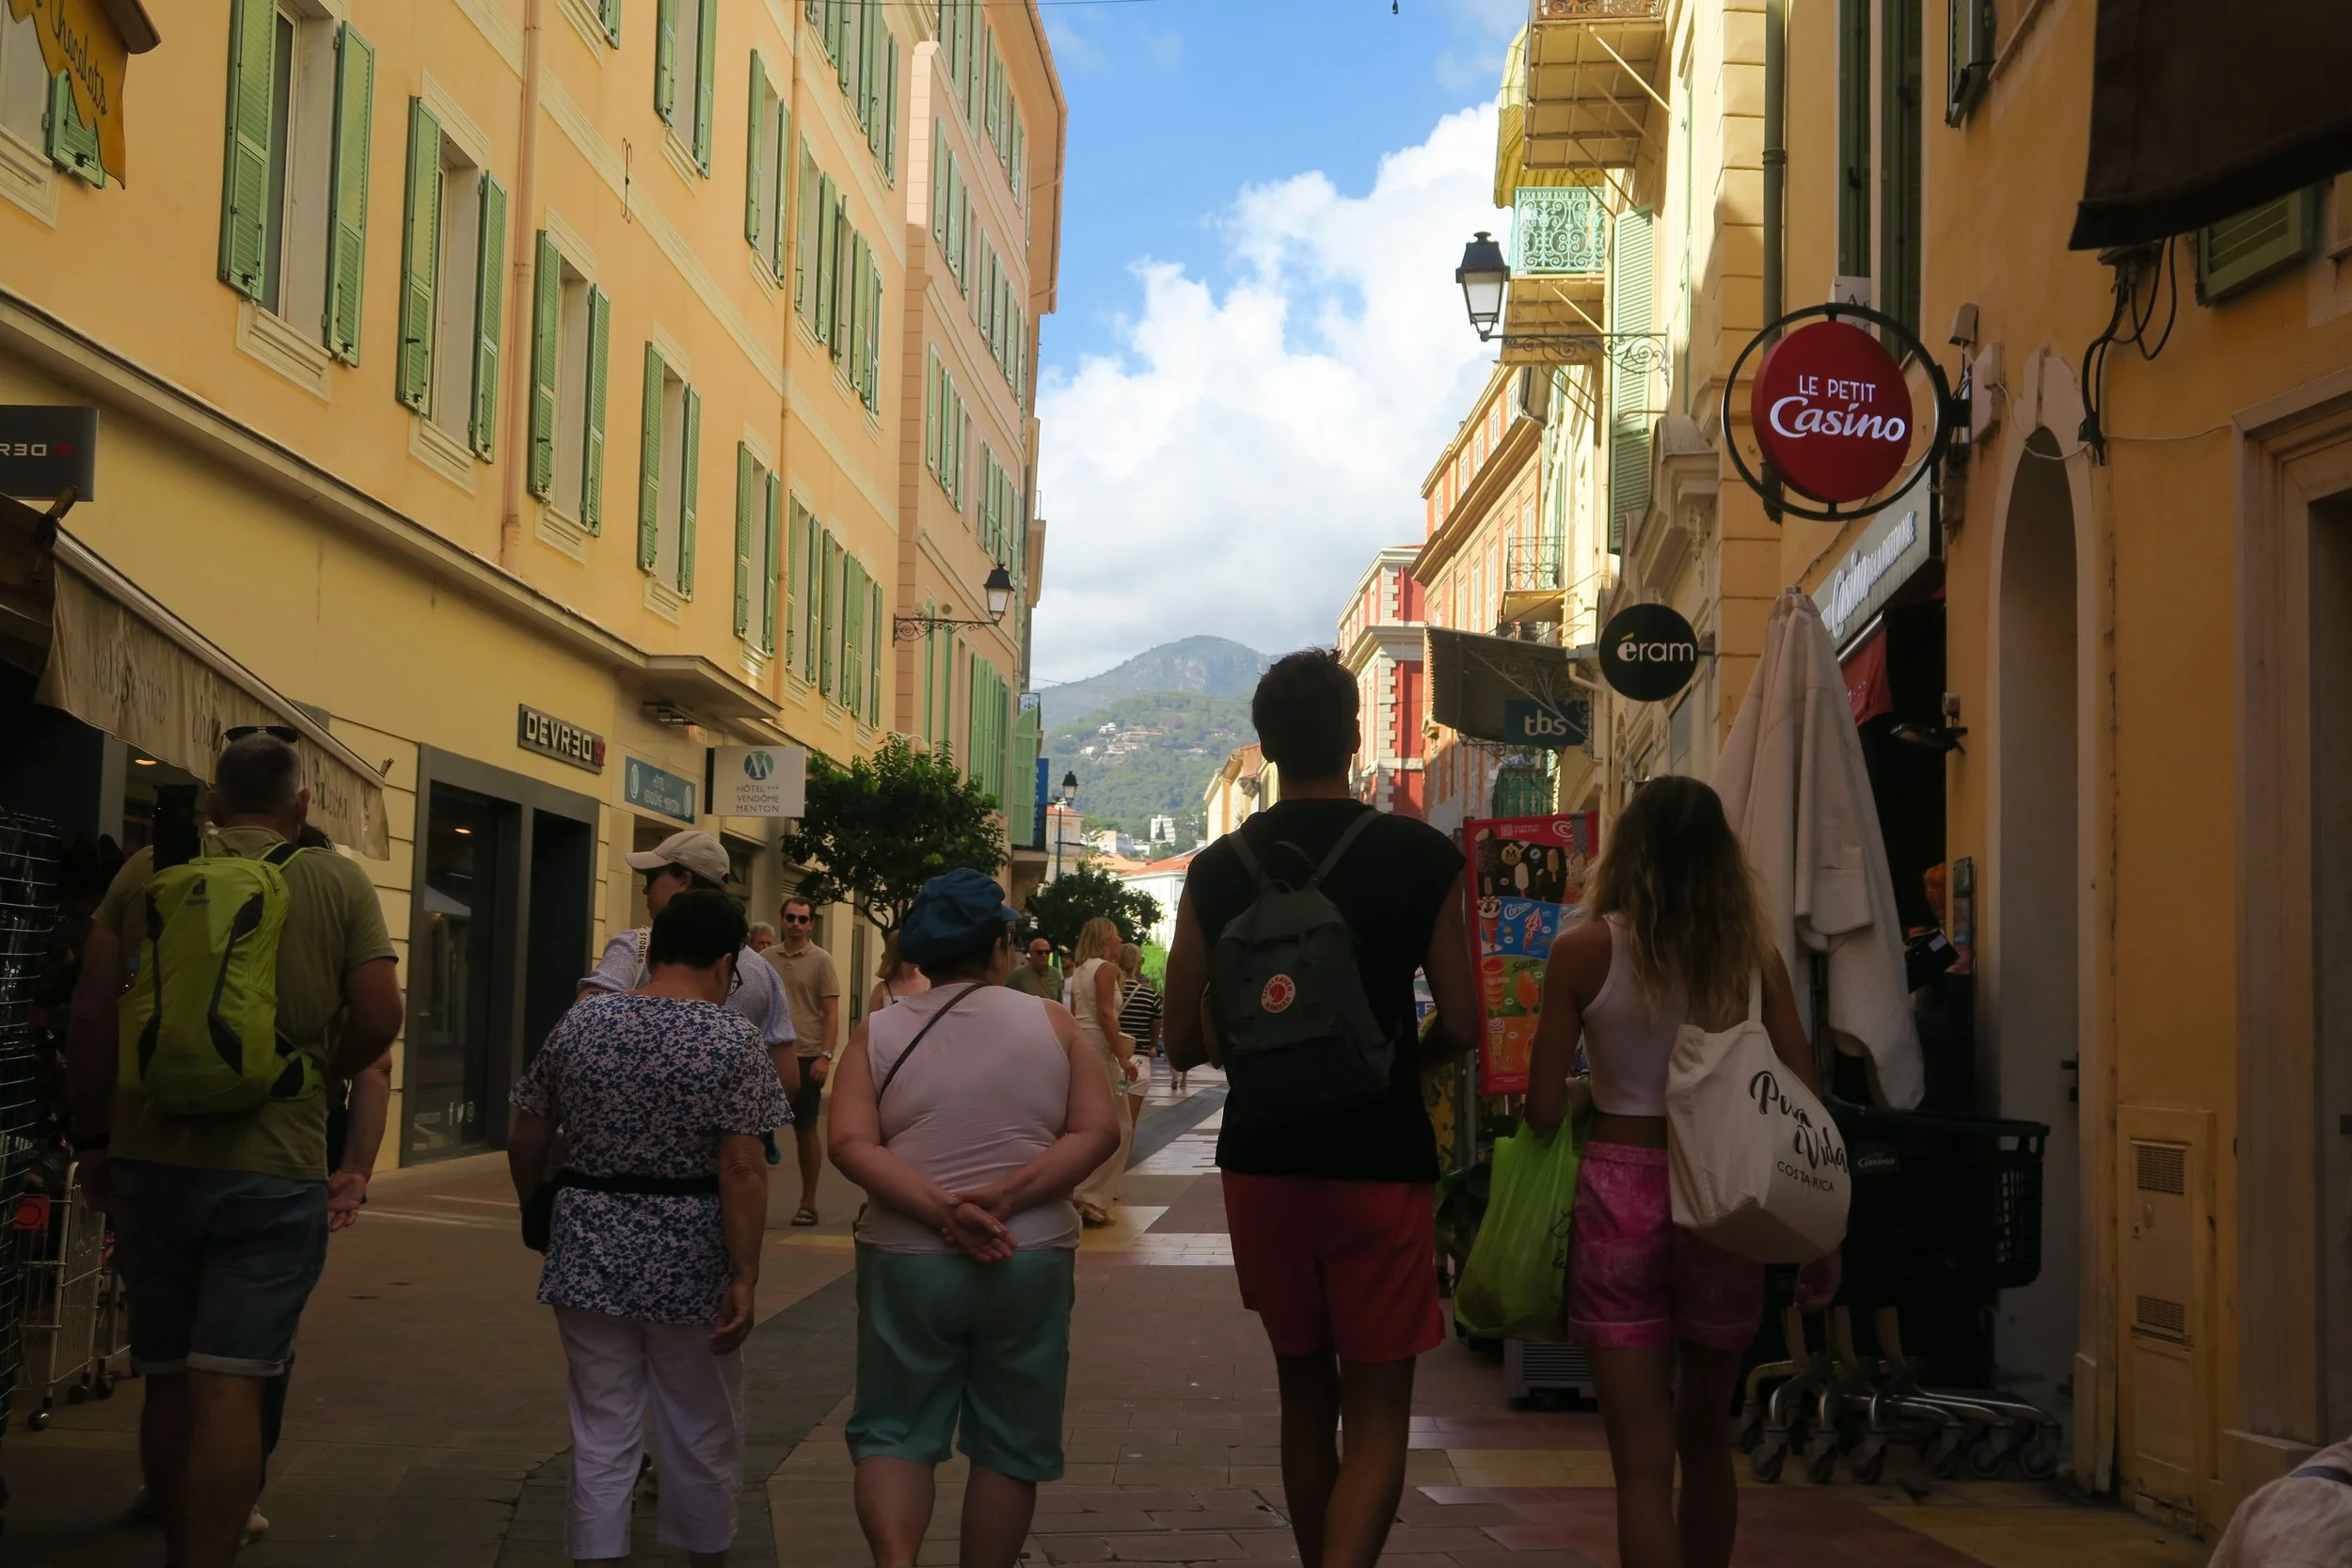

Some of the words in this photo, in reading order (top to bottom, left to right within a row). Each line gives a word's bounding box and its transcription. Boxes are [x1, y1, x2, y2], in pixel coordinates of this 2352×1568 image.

[1799, 374, 1820, 396] LE
[1828, 378, 1877, 404] PETIT
[1770, 395, 1906, 443] Casino
[1617, 632, 1693, 662] éram
[1524, 708, 1566, 736] tbs
[737, 784, 765, 792] HÔTEL
[737, 794, 779, 802] VENDÔME
[1504, 902, 1532, 921] Corn
[1748, 1070, 1813, 1128] Pua
[1793, 1124, 1848, 1174] Vida
[1777, 1161, 1810, 1185] COSTA
[1812, 1178, 1835, 1193] RICA
